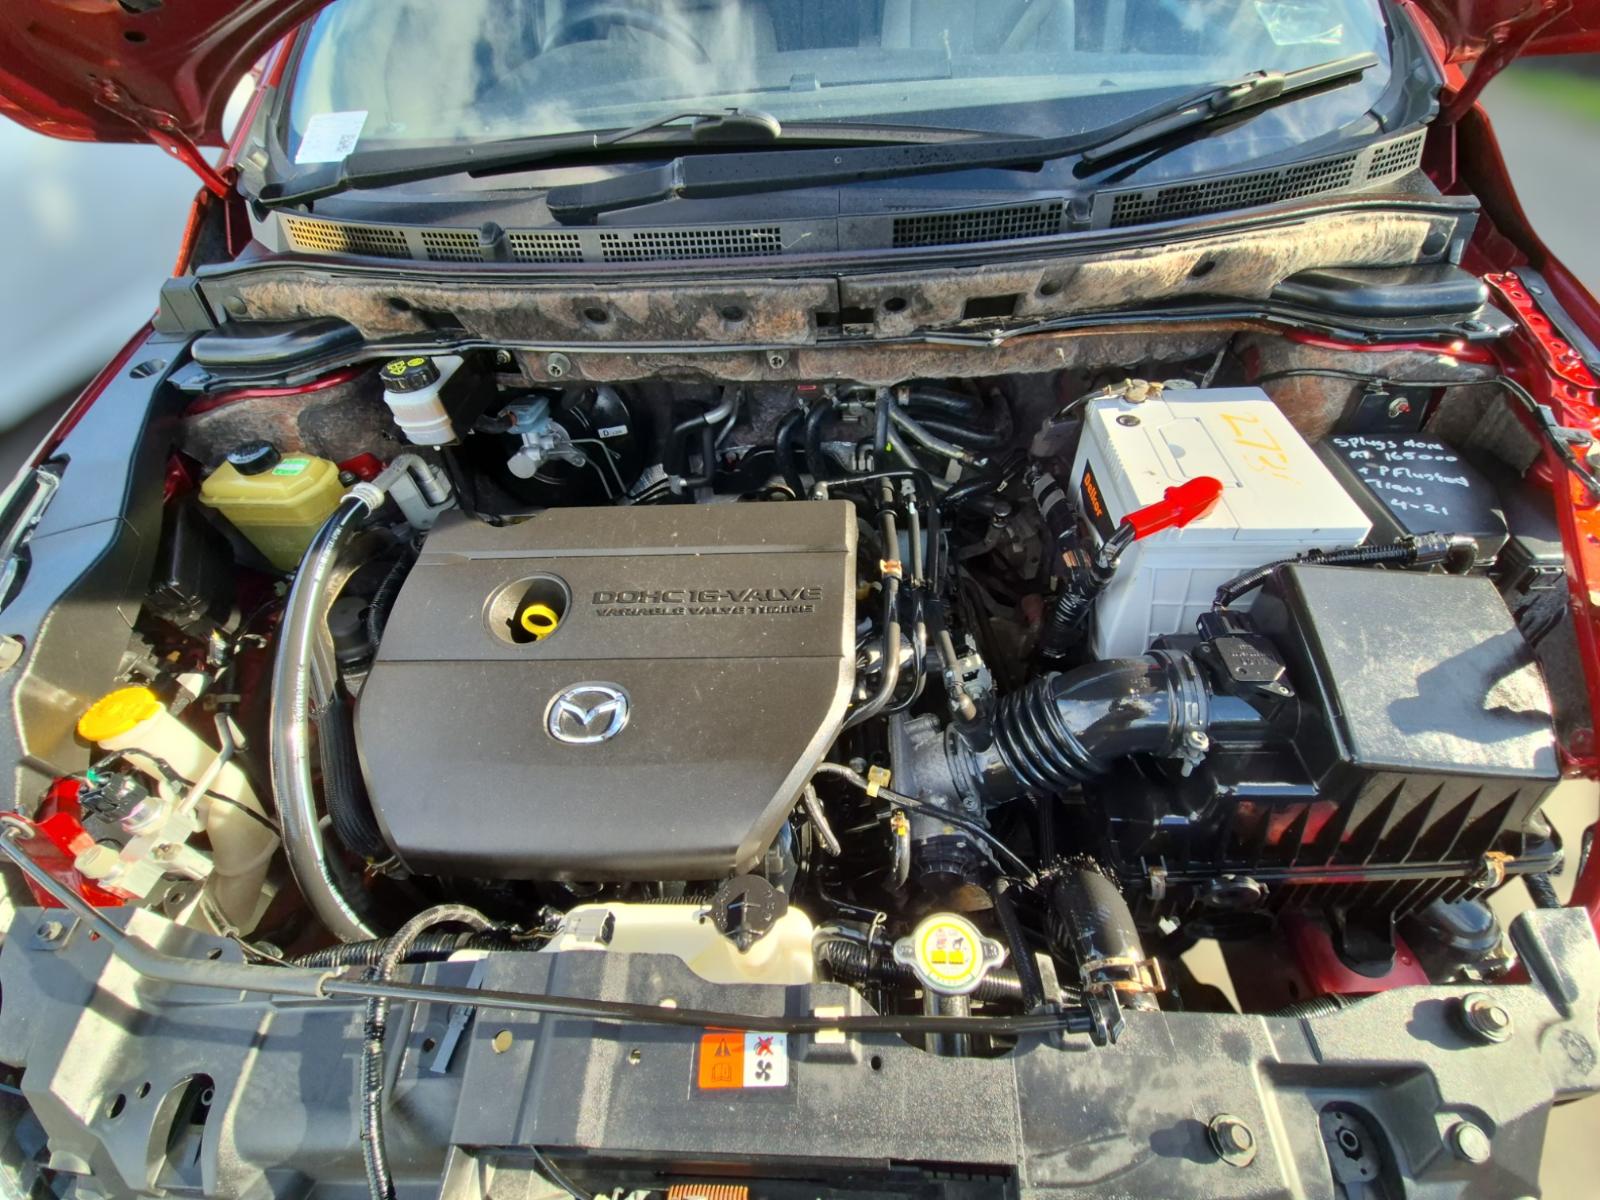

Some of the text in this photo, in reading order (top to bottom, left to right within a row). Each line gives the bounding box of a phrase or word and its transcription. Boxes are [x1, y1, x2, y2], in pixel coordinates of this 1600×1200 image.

[1083, 471, 1103, 518] Delkor
[592, 590, 687, 605] DOHC
[596, 607, 687, 617] VARIABLE
[687, 606, 747, 616] VALVE
